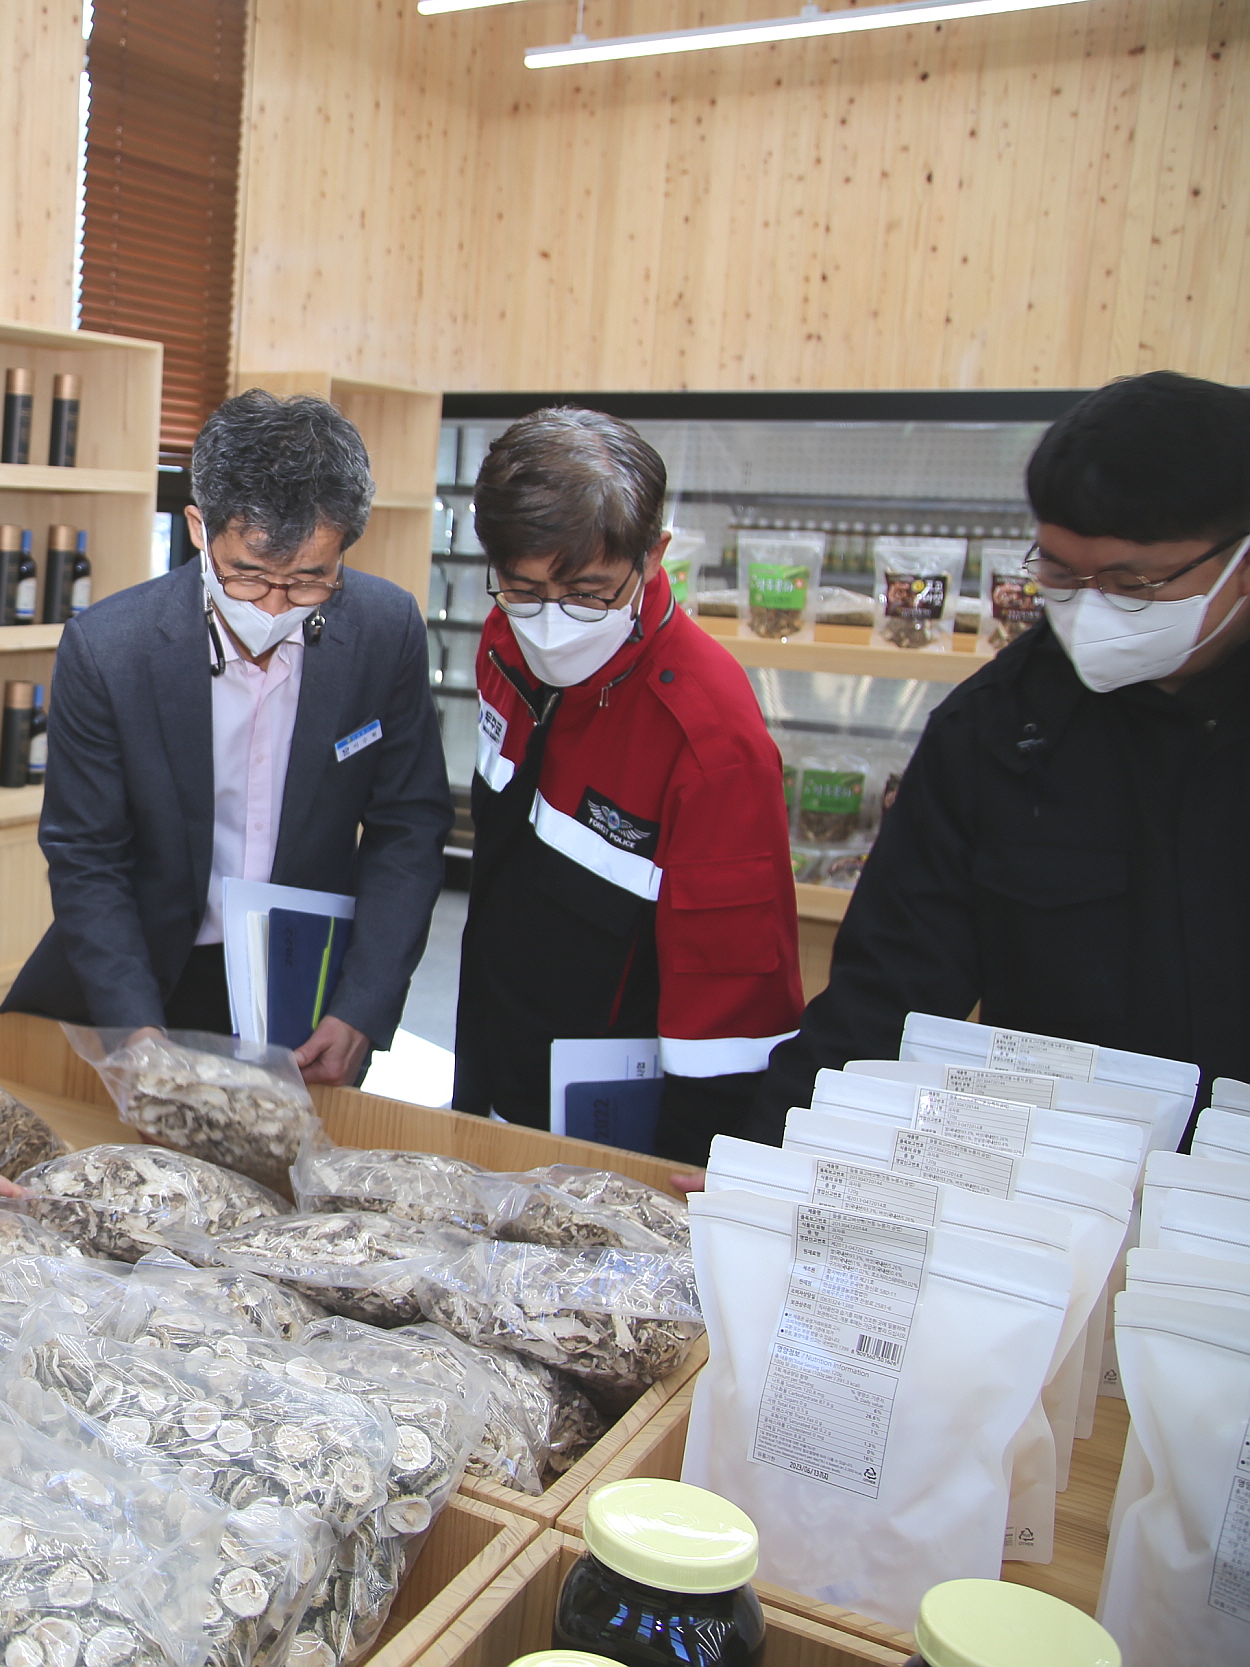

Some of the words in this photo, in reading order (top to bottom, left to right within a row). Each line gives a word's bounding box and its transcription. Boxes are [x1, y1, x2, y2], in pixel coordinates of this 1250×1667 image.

[484, 710, 503, 737] 무주군
[588, 817, 609, 836] FOREST
[609, 832, 636, 849] POLICE
[594, 1098, 611, 1139] 2022
[776, 1345, 801, 1358] 영양정보
[806, 1355, 833, 1367] Nutrition
[833, 1363, 870, 1379] Information
[773, 1372, 790, 1381] Amount
[785, 1383, 802, 1391] Sodium
[783, 1396, 798, 1405] Sugars
[788, 1391, 818, 1404] Carbohydrate
[794, 1413, 806, 1421] Trans
[789, 1419, 810, 1429] Saturated
[777, 1428, 793, 1437] Protein
[787, 1425, 811, 1436] Cholesterol
